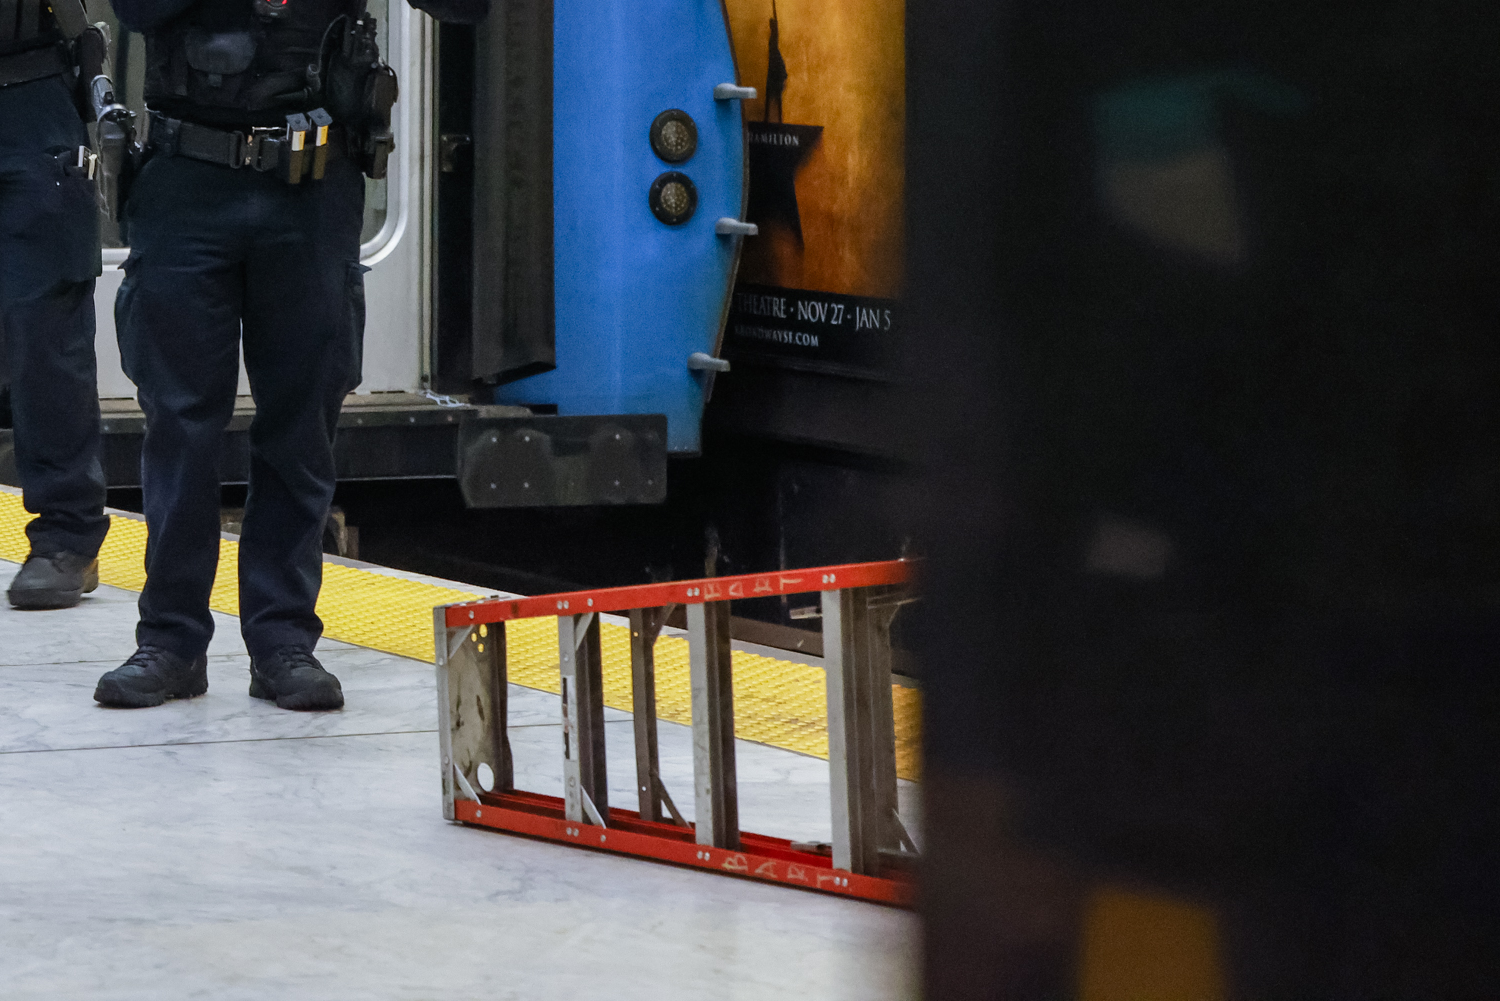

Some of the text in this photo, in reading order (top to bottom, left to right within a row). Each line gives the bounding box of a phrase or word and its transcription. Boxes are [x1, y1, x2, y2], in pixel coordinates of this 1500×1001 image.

[736, 293, 892, 331] THEATRE NOV 27 JAN 5
